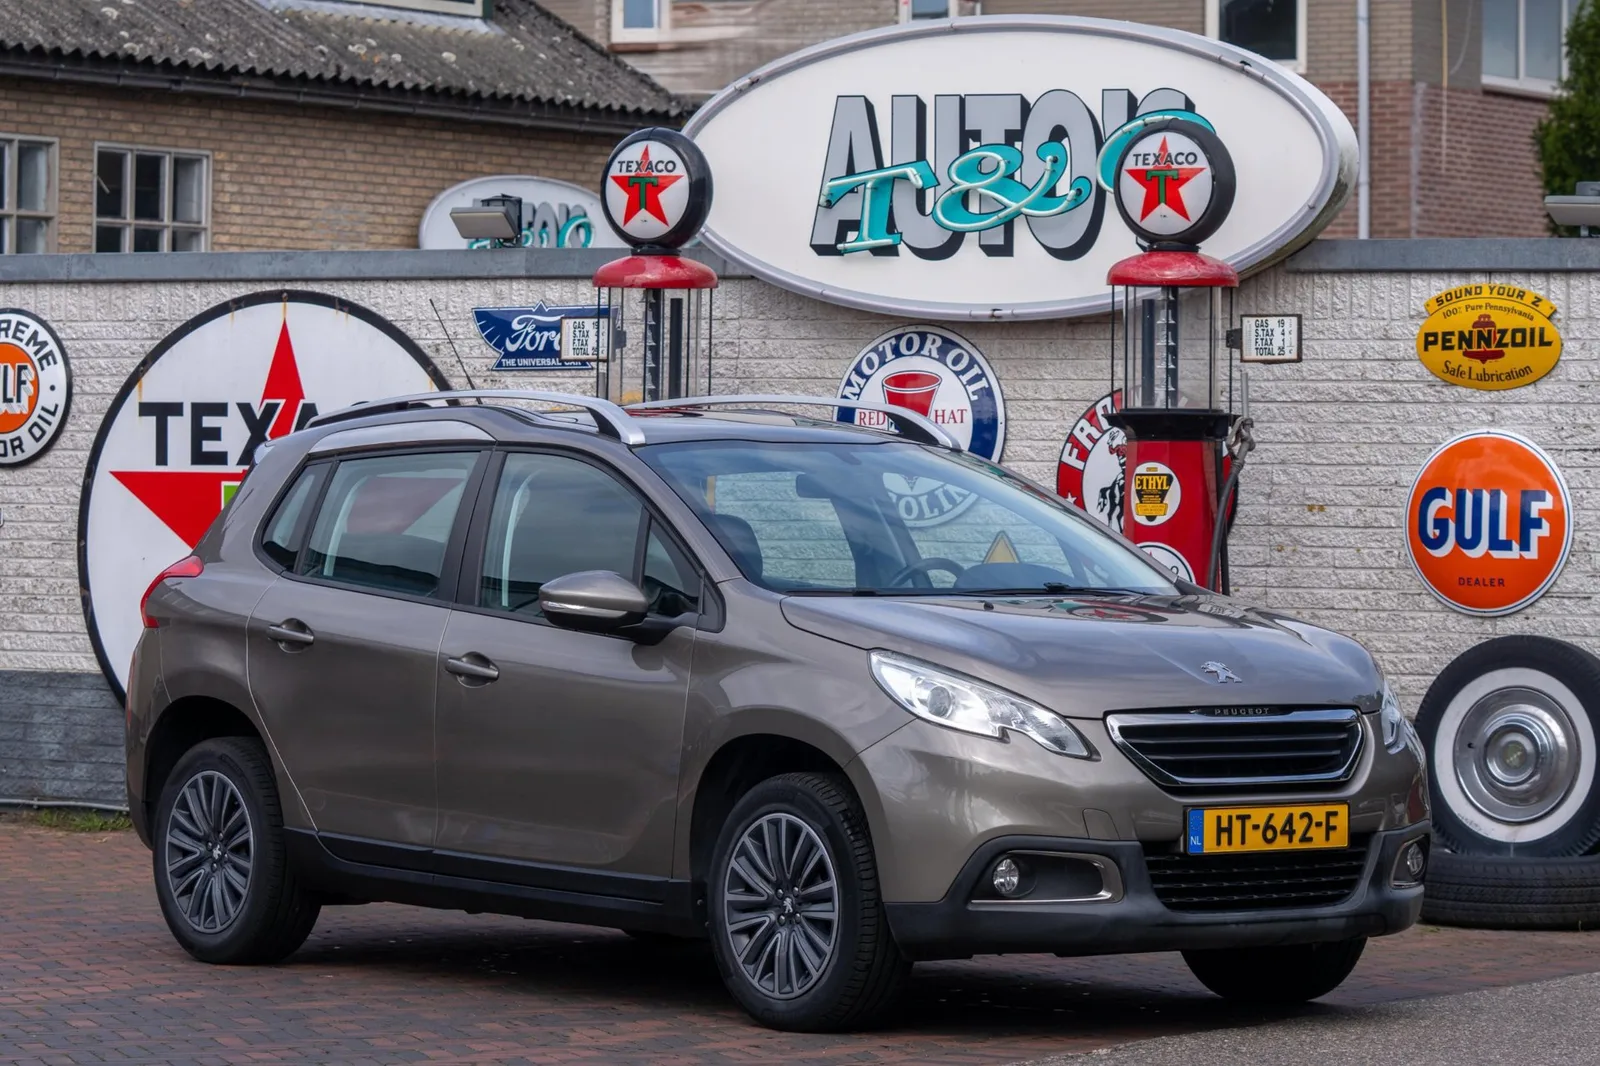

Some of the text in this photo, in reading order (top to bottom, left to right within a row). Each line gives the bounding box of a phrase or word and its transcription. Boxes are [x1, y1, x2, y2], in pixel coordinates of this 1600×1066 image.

[1133, 151, 1198, 166] TEXACO
[618, 160, 677, 173] TEXACO
[810, 87, 1196, 262] AUTO'
[628, 176, 659, 210] T
[1145, 169, 1179, 205] T
[1435, 285, 1543, 308] SOUND YOUR Z
[1465, 303, 1484, 313] Pure
[1484, 302, 1535, 322] Pennsylvania
[572, 321, 585, 330] GAS
[1254, 319, 1285, 328] GAS 19
[572, 330, 590, 339] S.TAX
[1254, 328, 1286, 338] S.TAX 4
[1423, 326, 1554, 352] PENNZOIL
[0, 319, 58, 371] REME
[572, 339, 589, 348] F.TAX
[1254, 338, 1286, 347] F.TAX 1
[572, 348, 590, 356] TOTAL
[1254, 347, 1286, 356] TOTAL 25
[501, 359, 516, 367] THE
[517, 358, 562, 366] UNIVERSAL
[843, 333, 990, 401] MOTOR OIL
[1442, 360, 1533, 382] Safe Lubrication
[28, 403, 59, 443] OIL
[858, 408, 968, 426] RED HAT
[1135, 475, 1170, 490] ETHYL
[887, 483, 971, 520] OLI
[1418, 486, 1554, 560] GULF
[1458, 577, 1505, 587] DEALER
[1214, 707, 1269, 716] PEUGEOT
[1216, 811, 1339, 847] HT-642-F
[1190, 836, 1202, 846] NL
